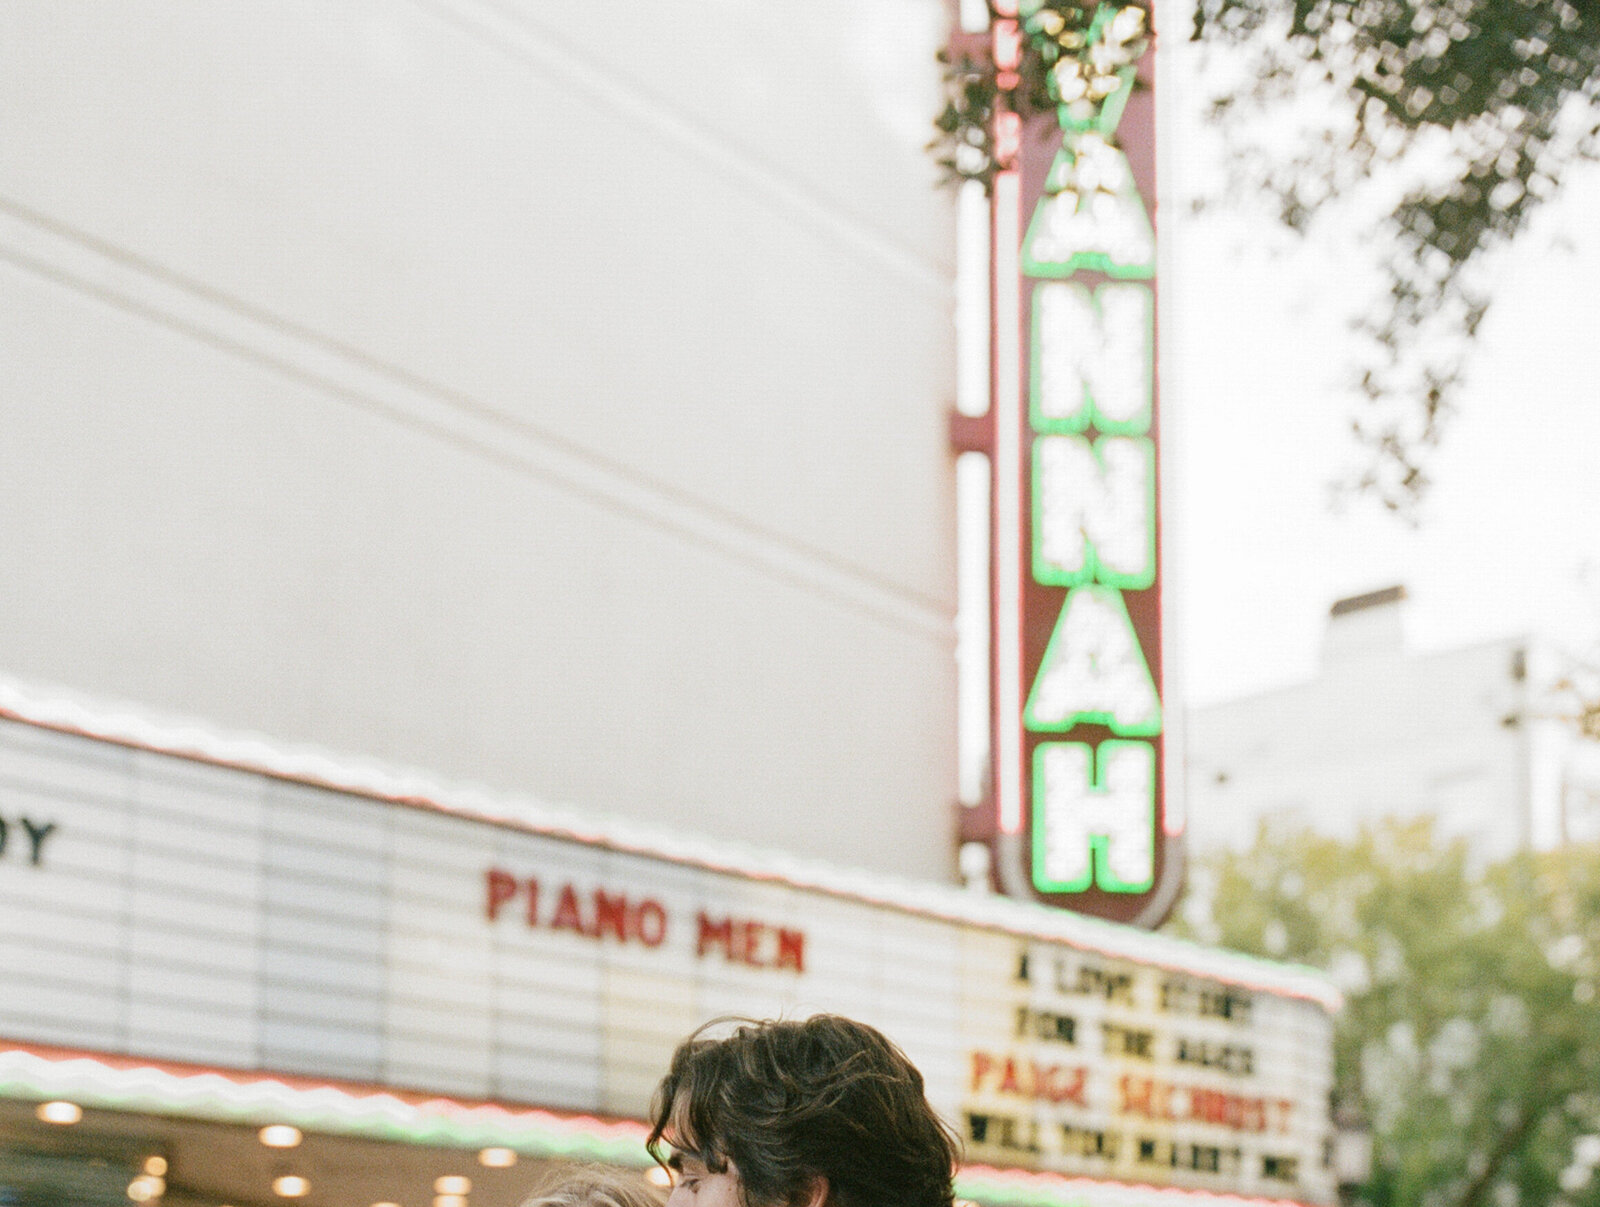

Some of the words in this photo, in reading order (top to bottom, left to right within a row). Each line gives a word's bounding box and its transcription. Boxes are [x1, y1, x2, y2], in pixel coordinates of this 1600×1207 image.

[0, 813, 56, 867] Y
[486, 867, 668, 948] PIANO
[697, 909, 807, 974] MEN
[1055, 955, 1134, 1007] LOVE
[1016, 1006, 1076, 1044] FOR
[1100, 1022, 1156, 1062] THE
[970, 1051, 1088, 1108] PAIGE
[966, 1111, 1040, 1152] WILL
[1060, 1123, 1120, 1160] YOU
